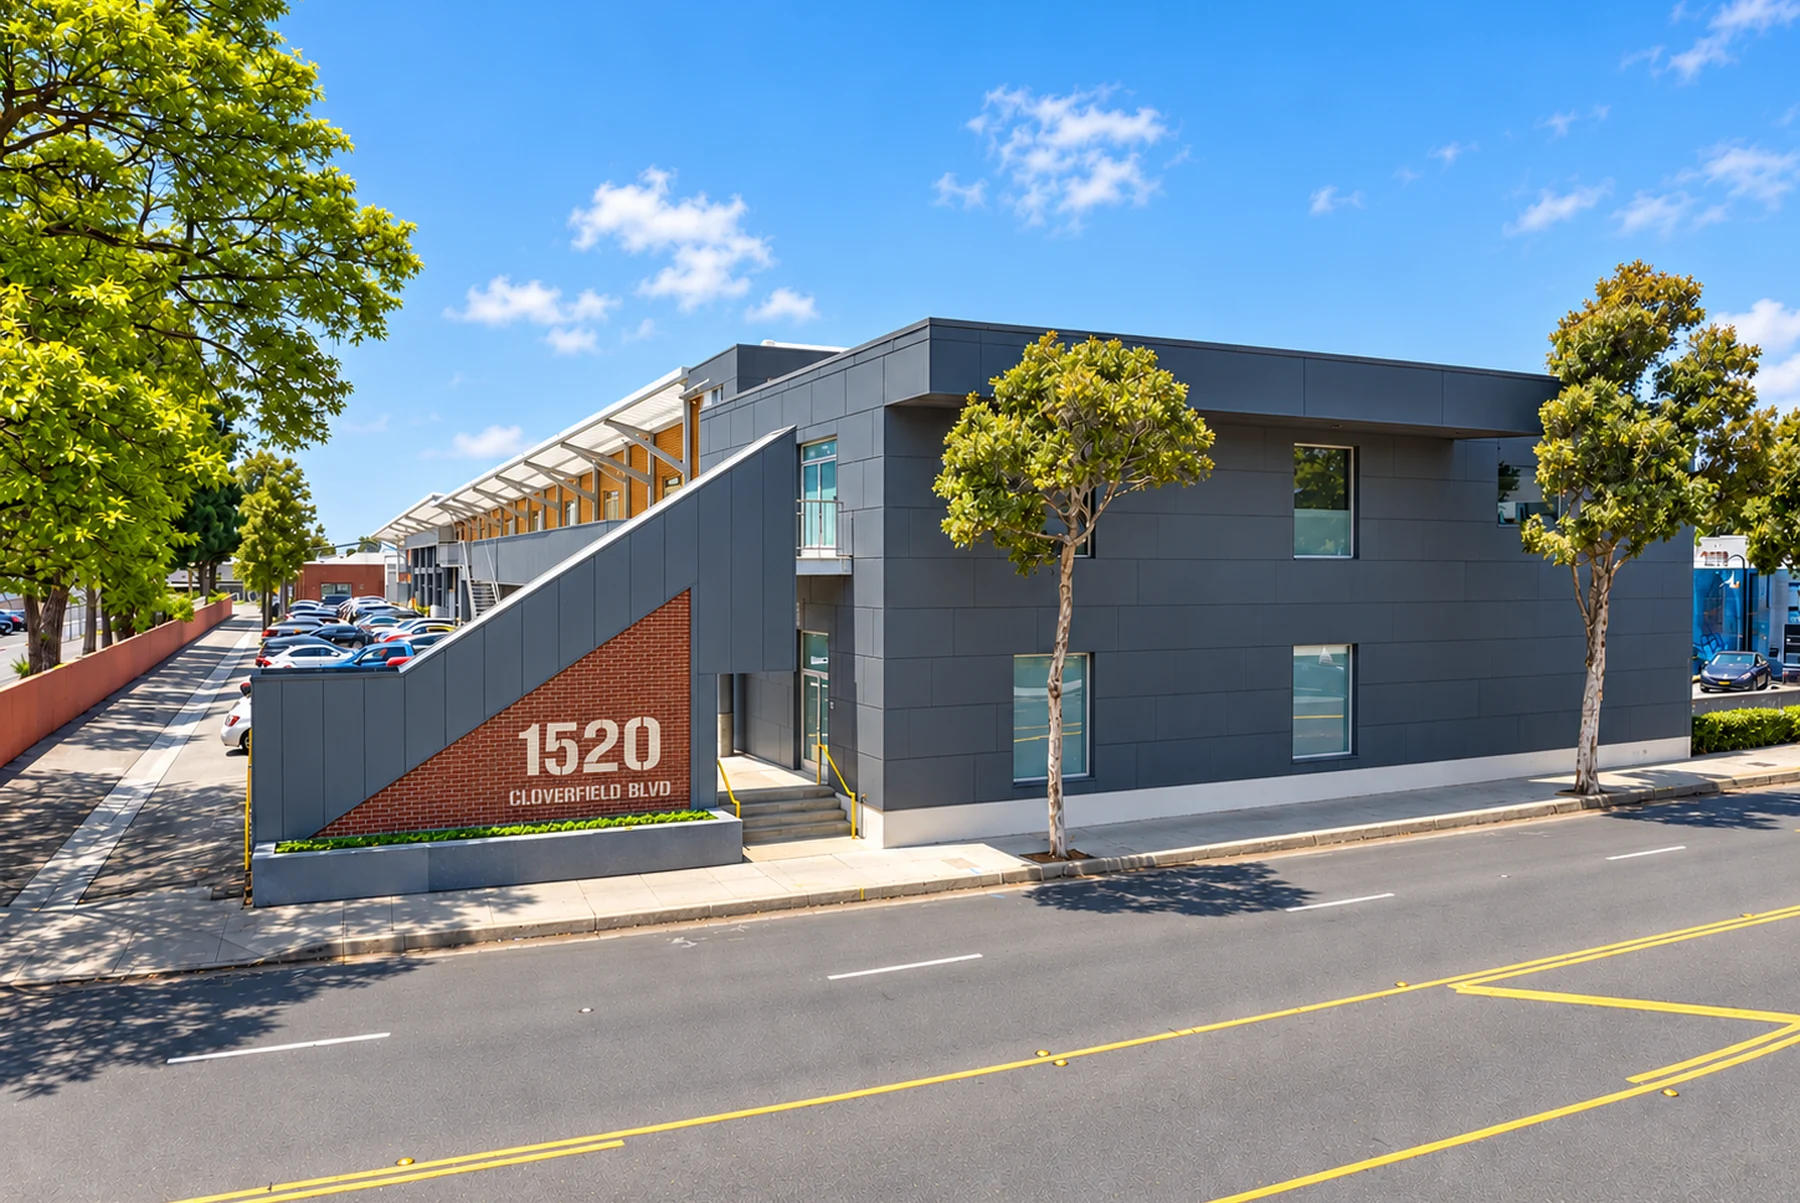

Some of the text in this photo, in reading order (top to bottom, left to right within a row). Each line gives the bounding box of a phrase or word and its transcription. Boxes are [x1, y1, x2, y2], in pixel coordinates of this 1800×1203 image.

[518, 716, 661, 776] 1520
[509, 781, 671, 806] CLOVERFIELD BLVD
